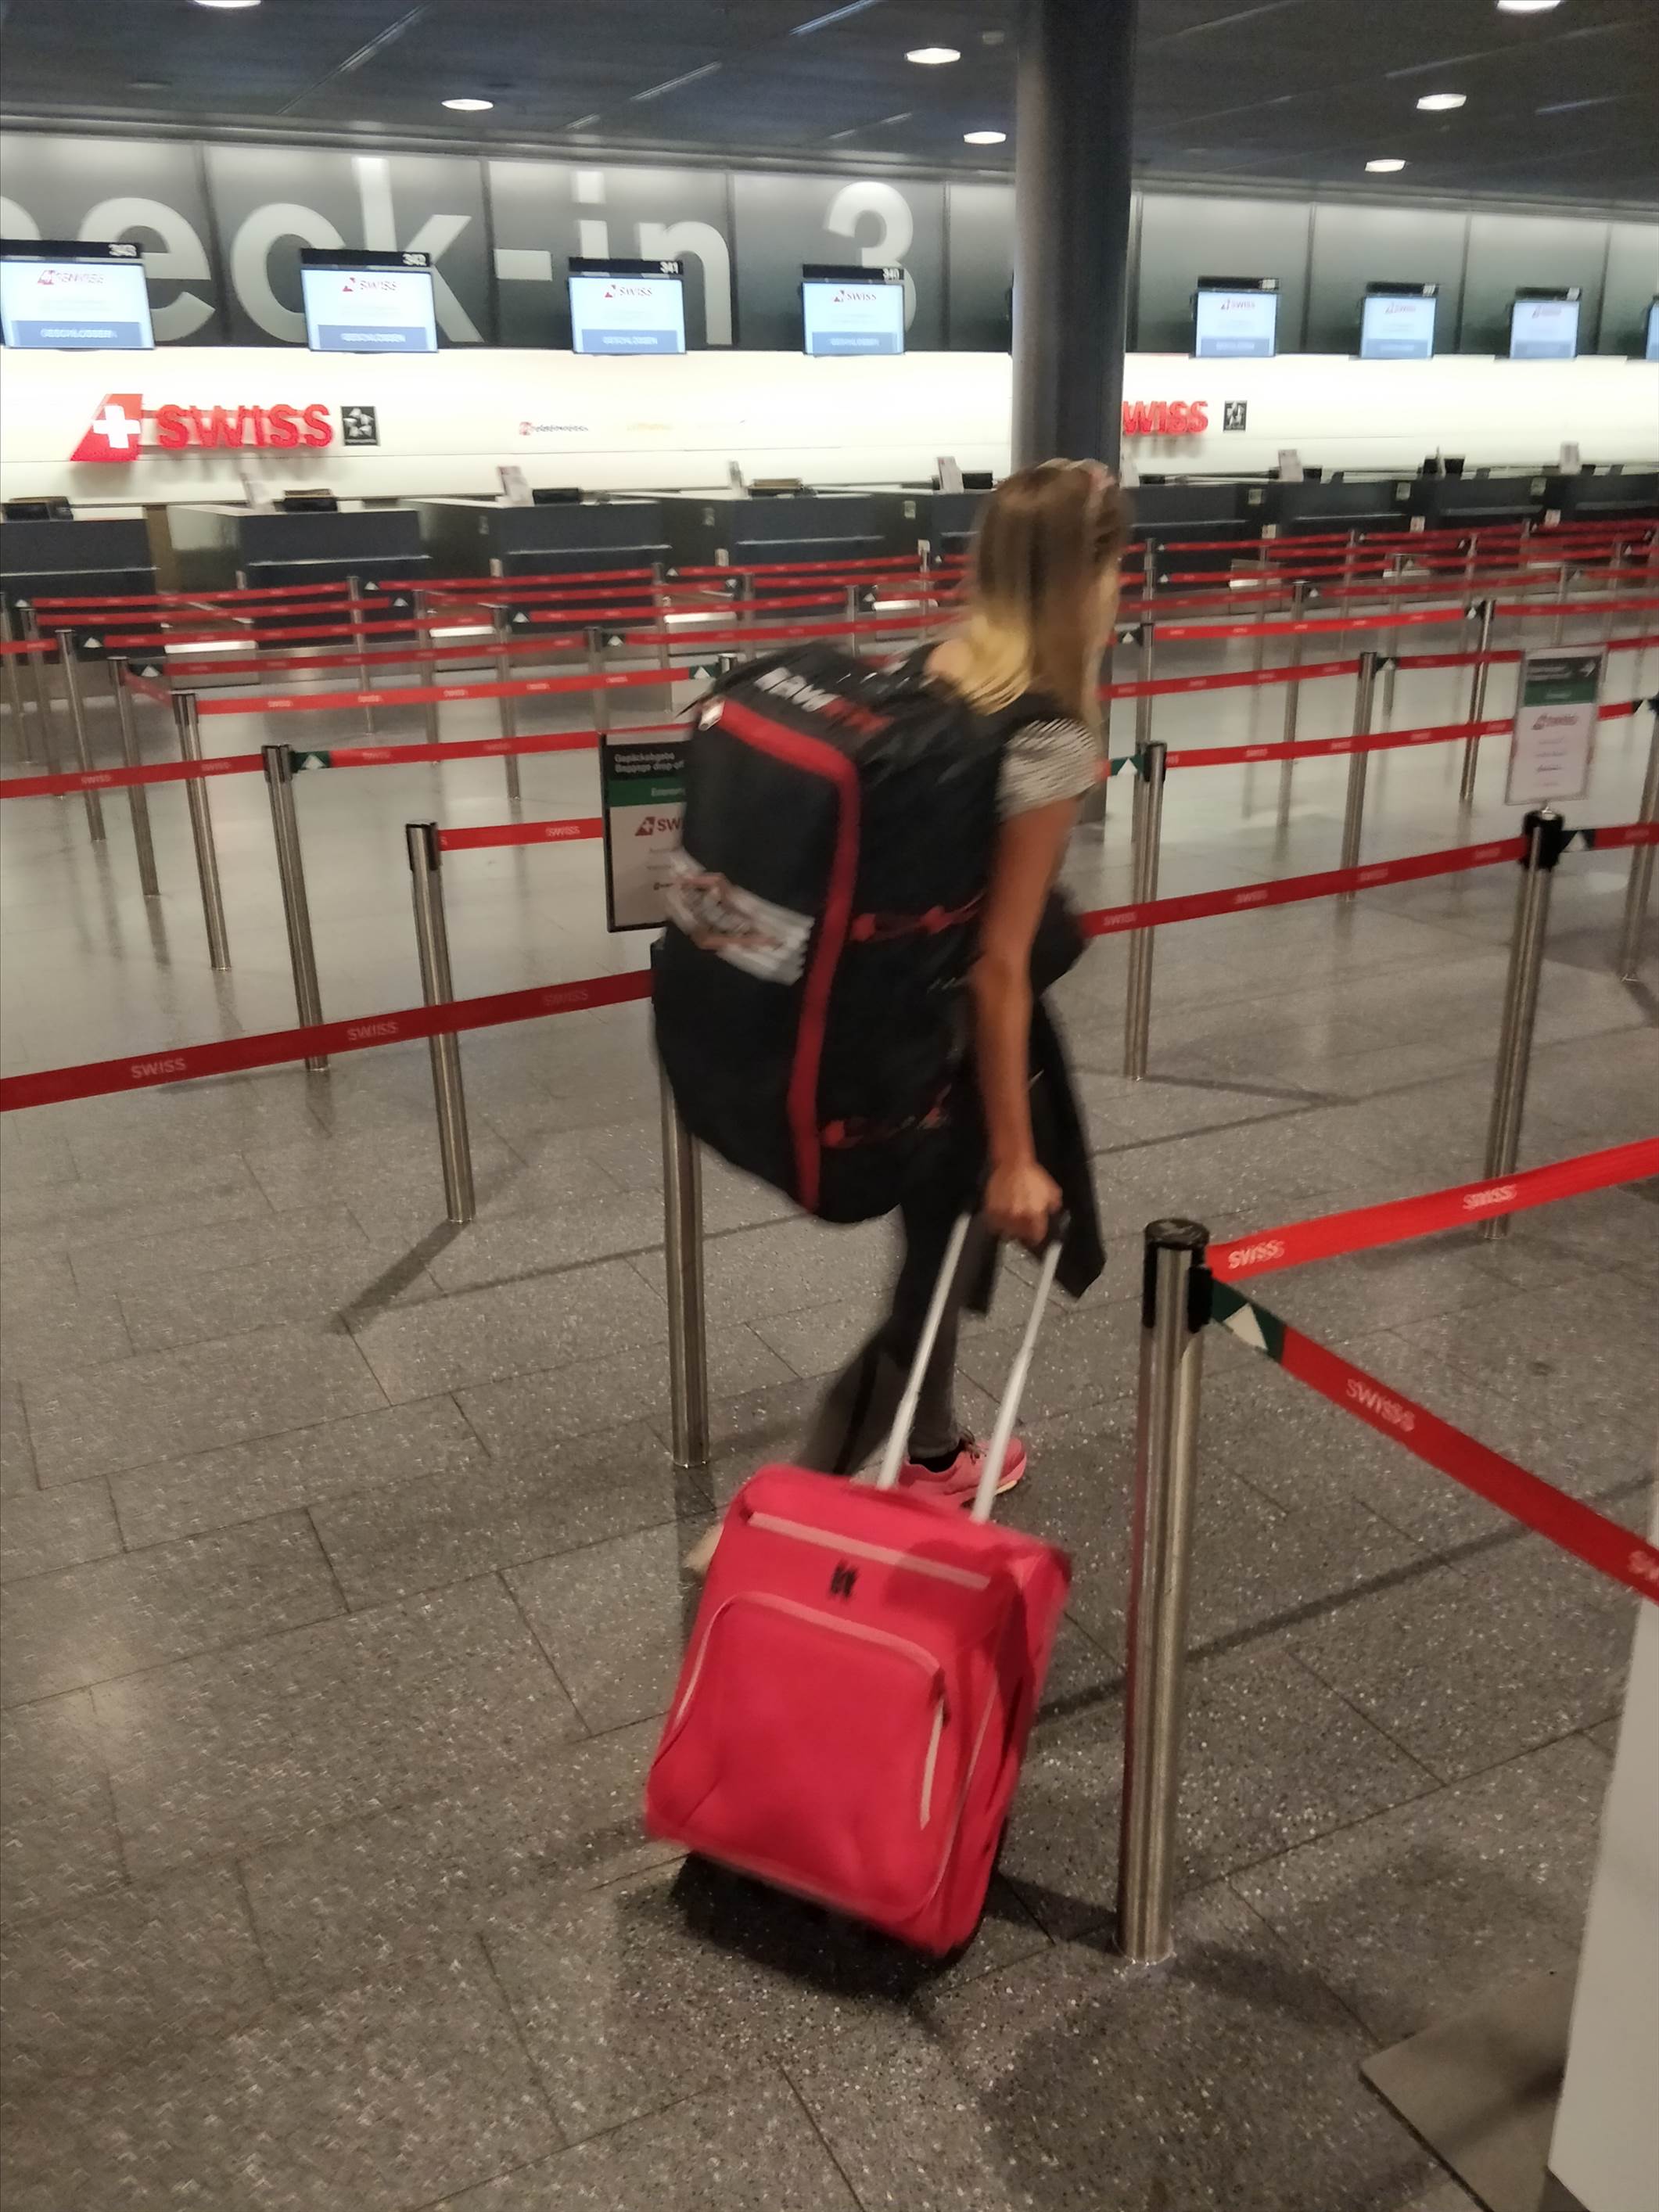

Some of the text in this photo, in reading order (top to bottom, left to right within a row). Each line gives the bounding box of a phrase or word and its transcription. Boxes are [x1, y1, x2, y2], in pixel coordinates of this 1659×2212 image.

[0, 156, 917, 344] eck-in 3
[360, 280, 397, 291] SWISS
[619, 286, 652, 296] SWISS
[846, 292, 877, 301] SWISS
[157, 404, 334, 450] SWISS
[546, 825, 581, 837] SWISS
[347, 1021, 399, 1041] SWISS
[131, 1058, 186, 1079] SWISS
[1227, 1240, 1284, 1270] SWISS
